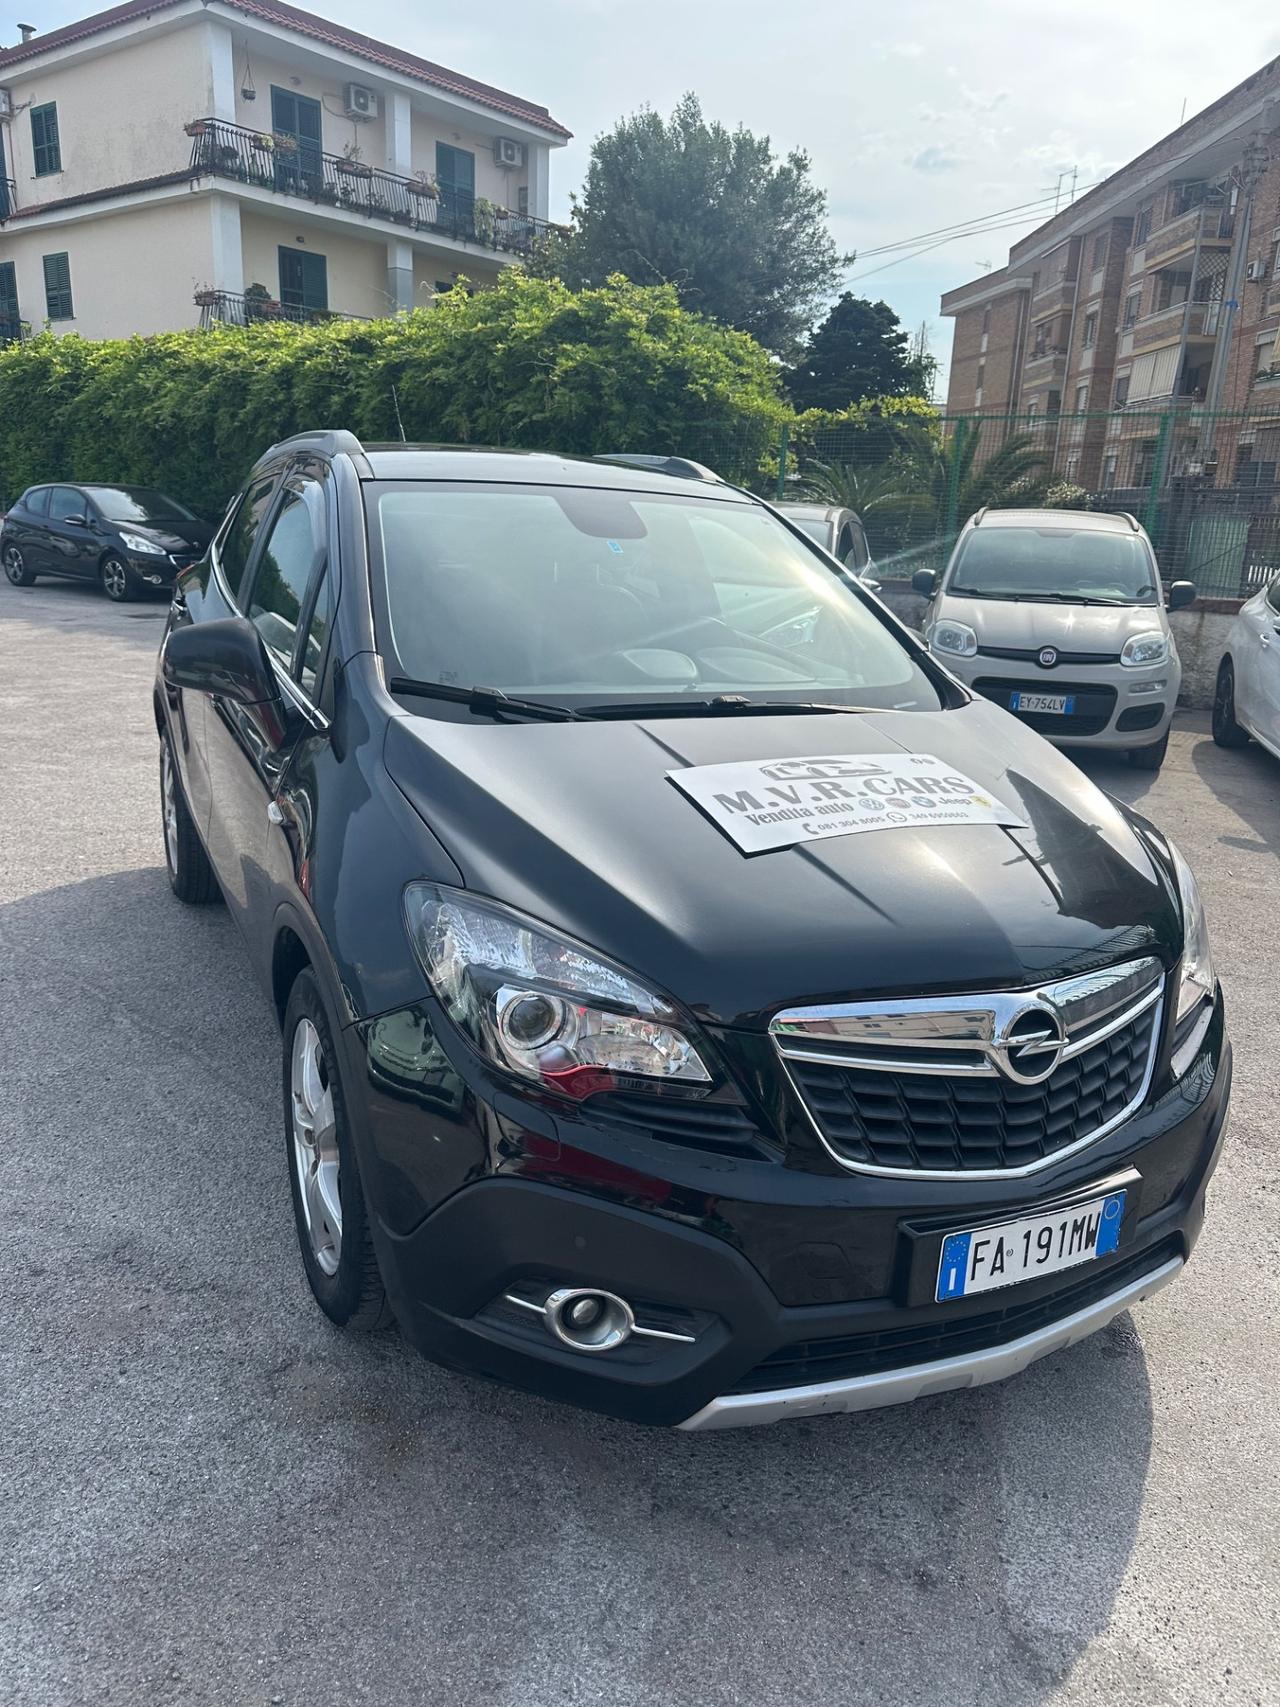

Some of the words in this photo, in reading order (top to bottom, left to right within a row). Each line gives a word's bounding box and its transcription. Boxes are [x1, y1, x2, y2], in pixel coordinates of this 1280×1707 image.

[1020, 696, 1032, 708] EY
[745, 806, 812, 826] Vendita
[817, 801, 853, 816] auto
[970, 1237, 1005, 1281] FA
[1023, 1213, 1100, 1267] 191MW
